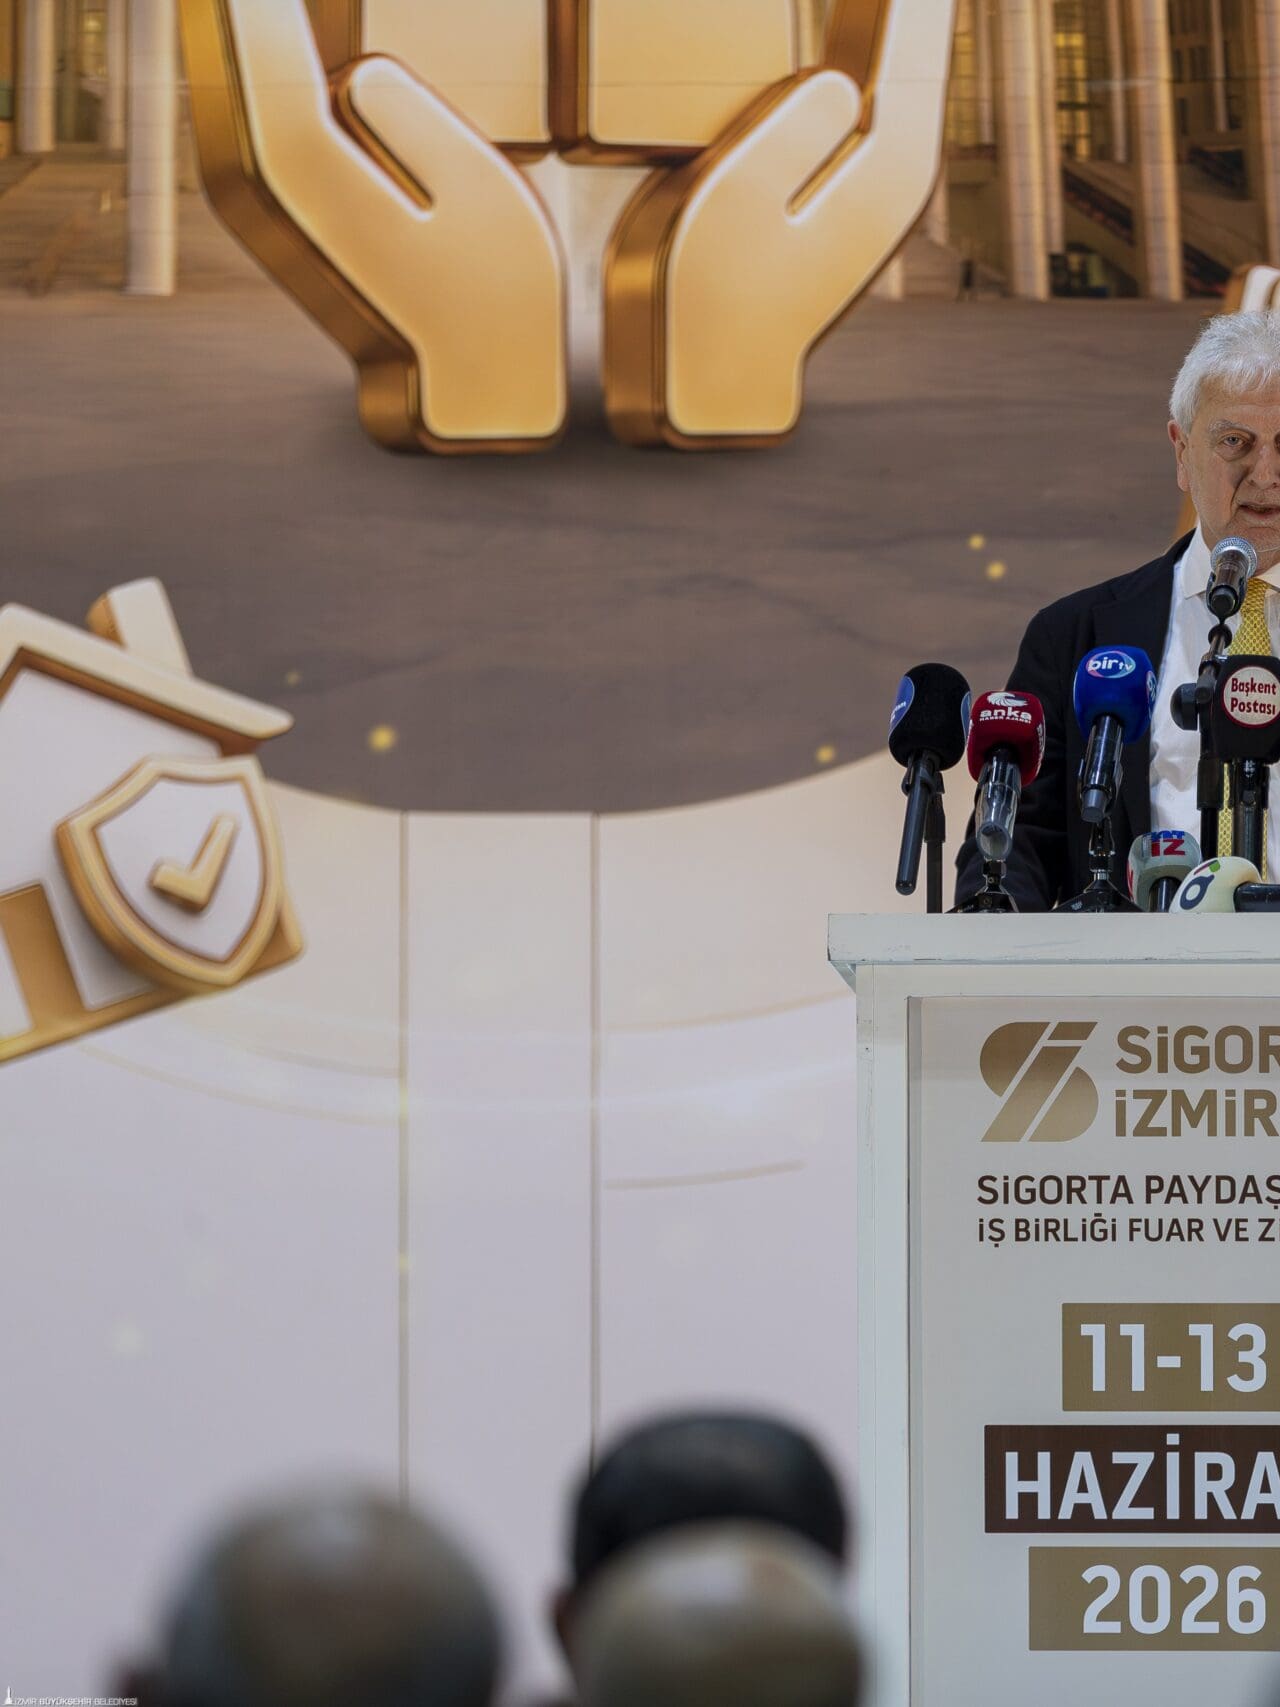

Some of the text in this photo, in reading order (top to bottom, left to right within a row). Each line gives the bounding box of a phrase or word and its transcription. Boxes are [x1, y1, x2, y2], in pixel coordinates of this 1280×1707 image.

[1231, 677, 1277, 697] Başkent
[980, 706, 1032, 721] anka
[1230, 697, 1276, 715] Postası
[1115, 1089, 1280, 1137] İZMİR
[977, 1174, 1134, 1205] SİGORTA
[978, 1217, 1006, 1247] İŞ
[1014, 1212, 1117, 1243] BİRLİĞİ
[1128, 1217, 1204, 1243] FUAR
[1212, 1217, 1250, 1243] VE
[1080, 1322, 1267, 1393] 11-13
[1081, 1564, 1266, 1635] 2026
